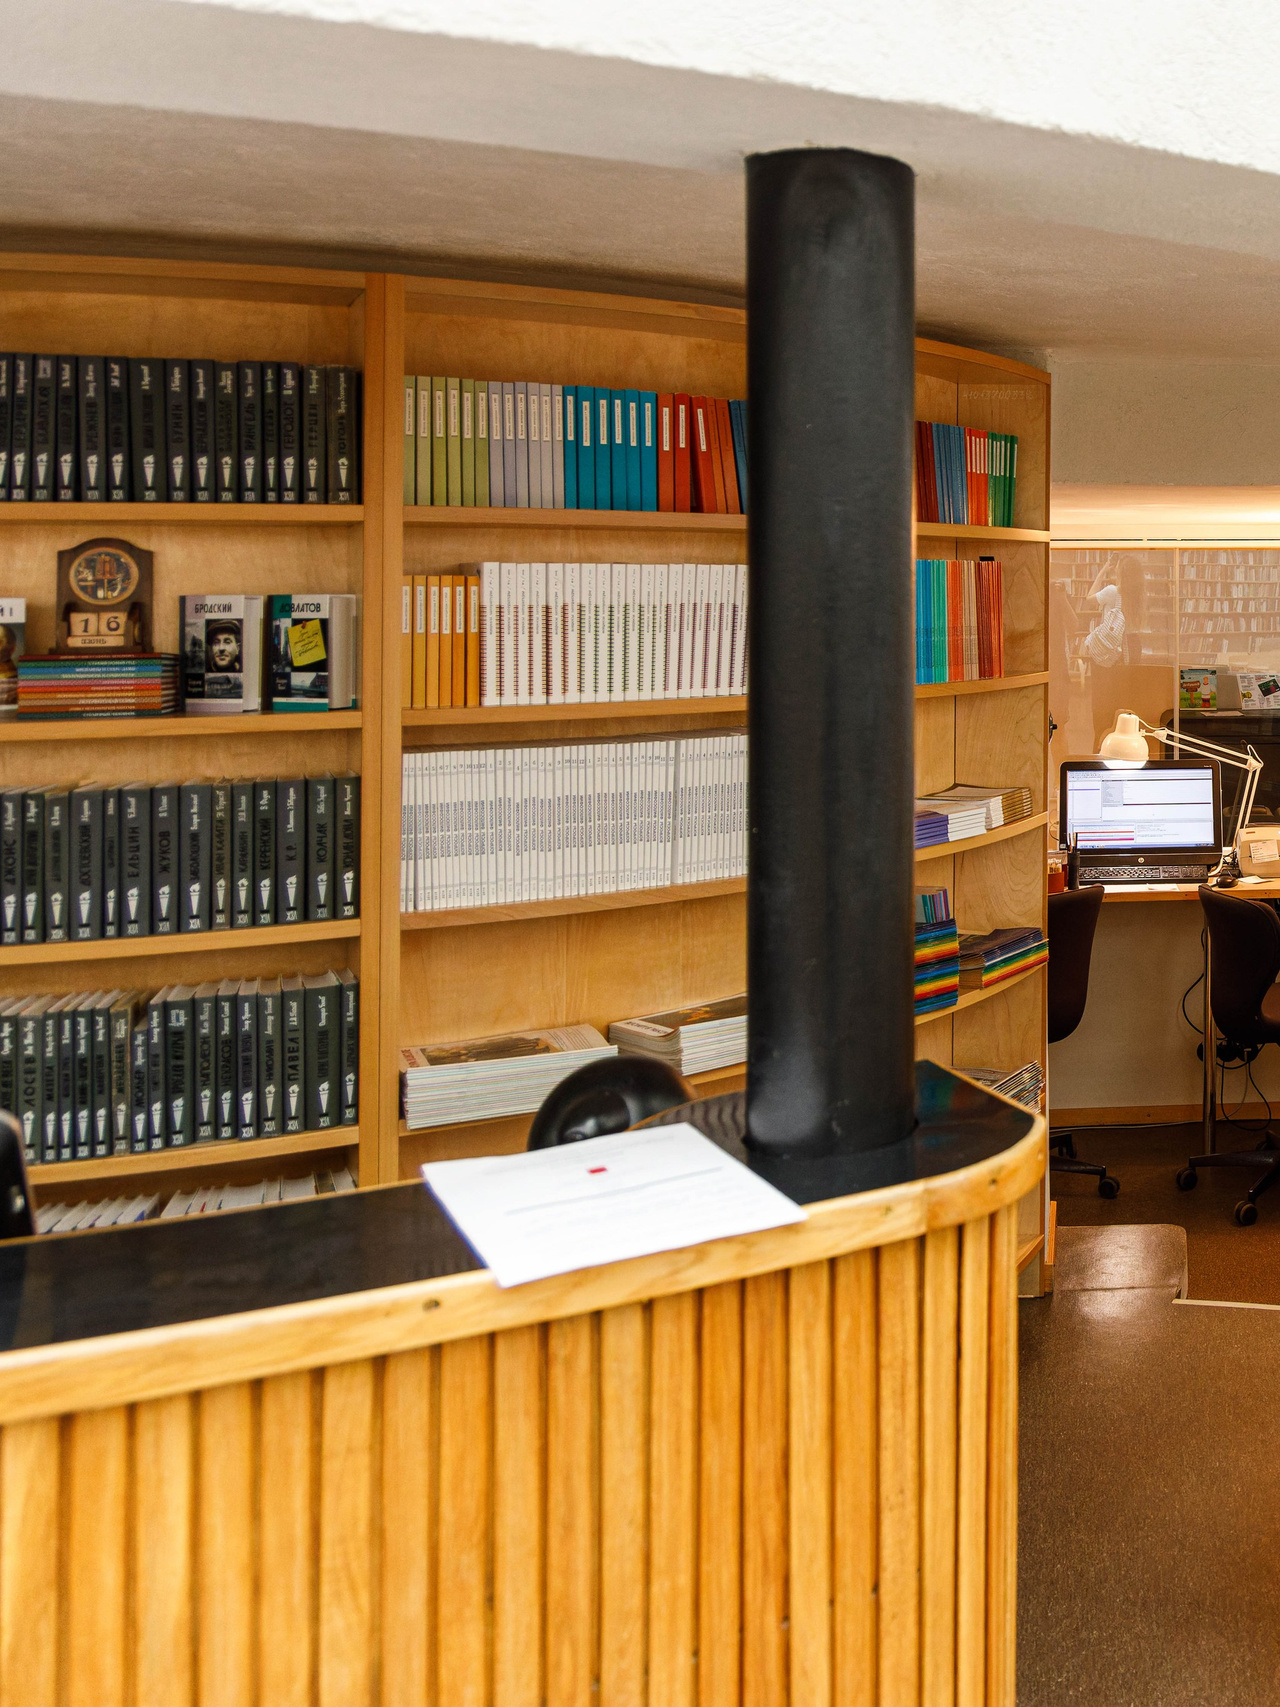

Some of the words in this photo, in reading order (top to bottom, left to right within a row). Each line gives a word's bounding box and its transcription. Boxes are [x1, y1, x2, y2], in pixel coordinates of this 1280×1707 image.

[195, 602, 232, 613] БРОДСКИЙ
[280, 602, 321, 613] ДОВЛАТОВ
[127, 826, 141, 878] ЕЛЬЦИН
[158, 830, 171, 874] ЖУКОВ
[258, 818, 271, 871] КЕРЕНСКИЙ
[316, 822, 328, 864] КОЛЧАК
[23, 1056, 36, 1107] ЛОСЕВ
[199, 1035, 212, 1087] НАПОЛЕОН
[220, 1038, 232, 1087] НЕКРАСОВ
[287, 1036, 300, 1082] ПАВЕЛ
[134, 1069, 145, 1108] МОЛЬЕР
